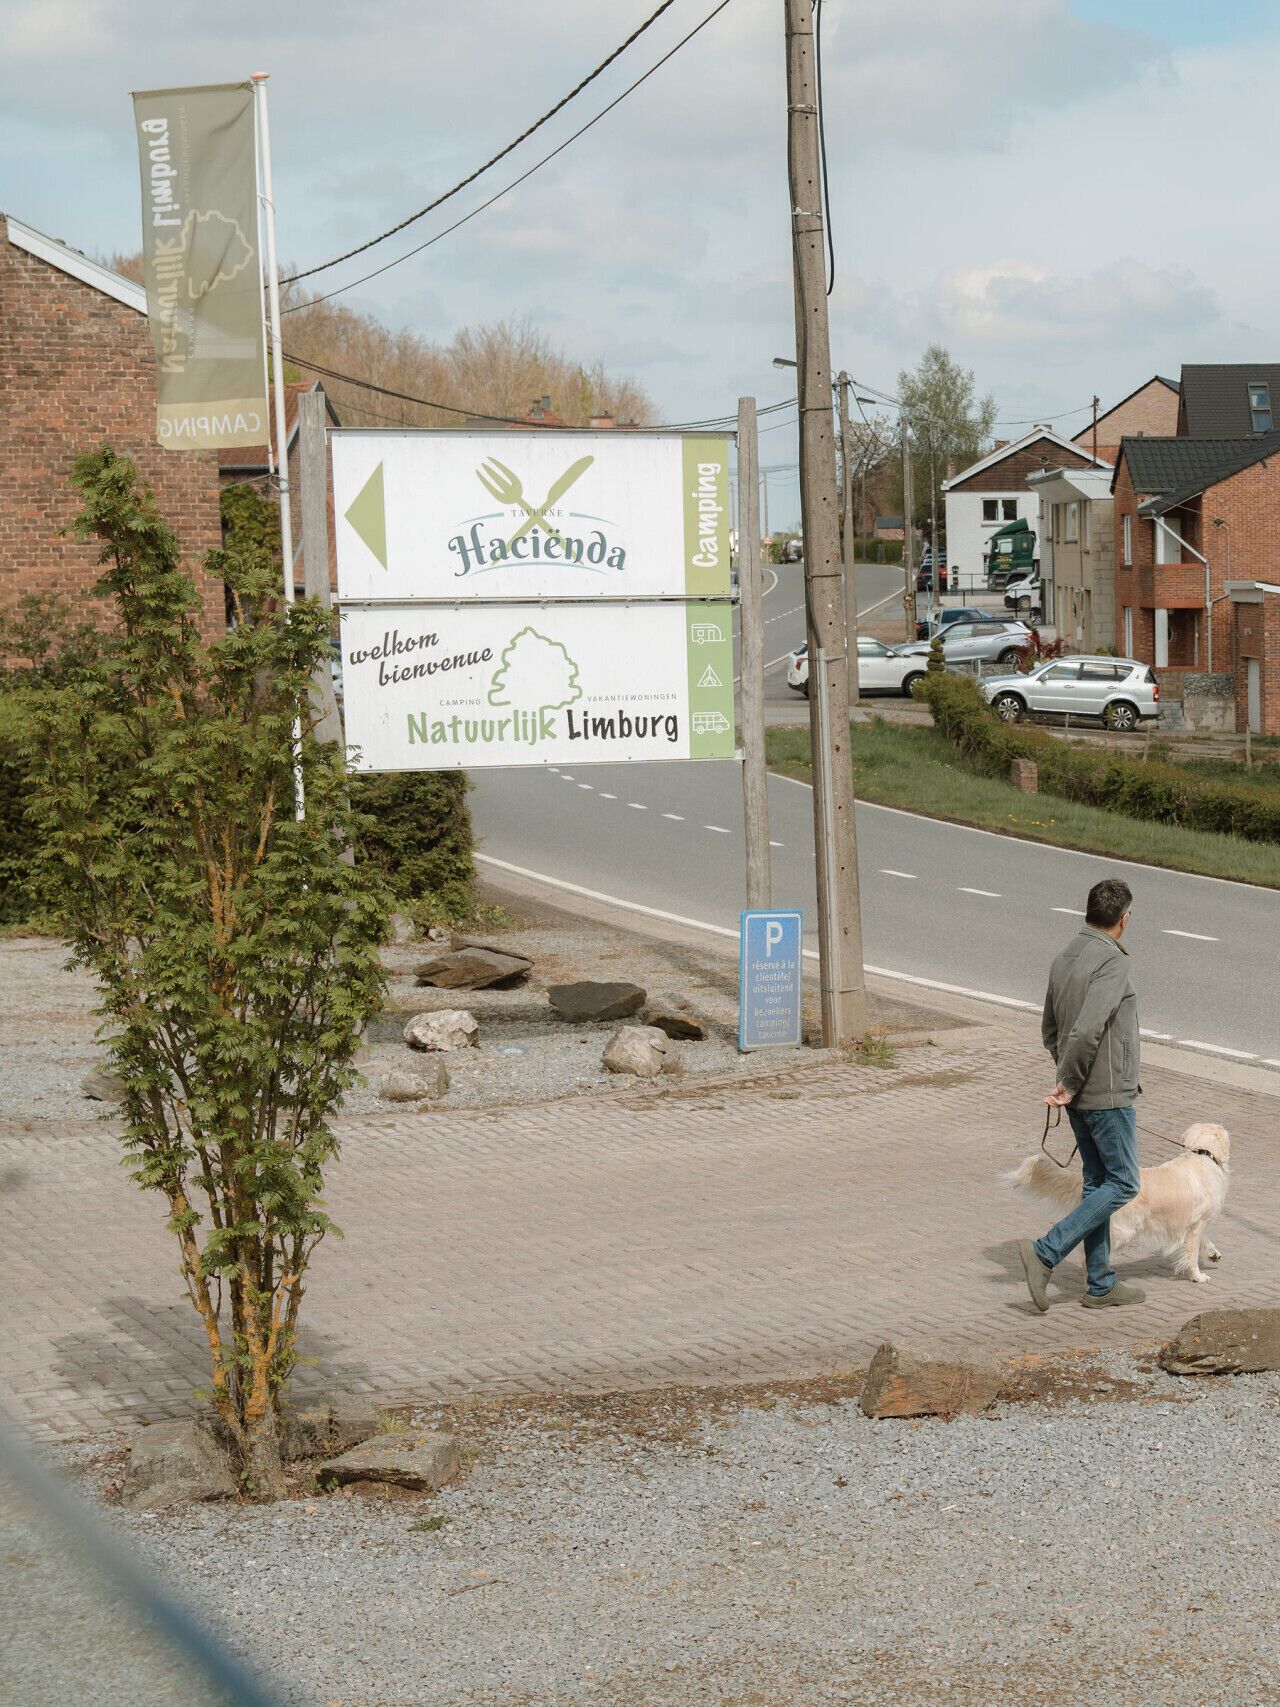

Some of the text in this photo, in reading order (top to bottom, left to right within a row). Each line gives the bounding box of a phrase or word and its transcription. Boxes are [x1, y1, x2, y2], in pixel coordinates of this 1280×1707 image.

[510, 508, 564, 519] TAVERNE
[692, 462, 722, 568] Camping
[447, 523, 627, 577] Haciënda
[349, 629, 440, 666] welkom
[378, 646, 494, 688] bienvenue
[439, 698, 482, 707] CAMPING
[586, 692, 678, 702] VAKANTIEWONINGEN
[406, 708, 679, 746] Natuurlijk Limburg
[766, 921, 784, 957] P
[787, 960, 795, 969] la
[752, 983, 794, 993] uitsluitend
[764, 995, 782, 1004] voor
[754, 1006, 792, 1017] bezoekers
